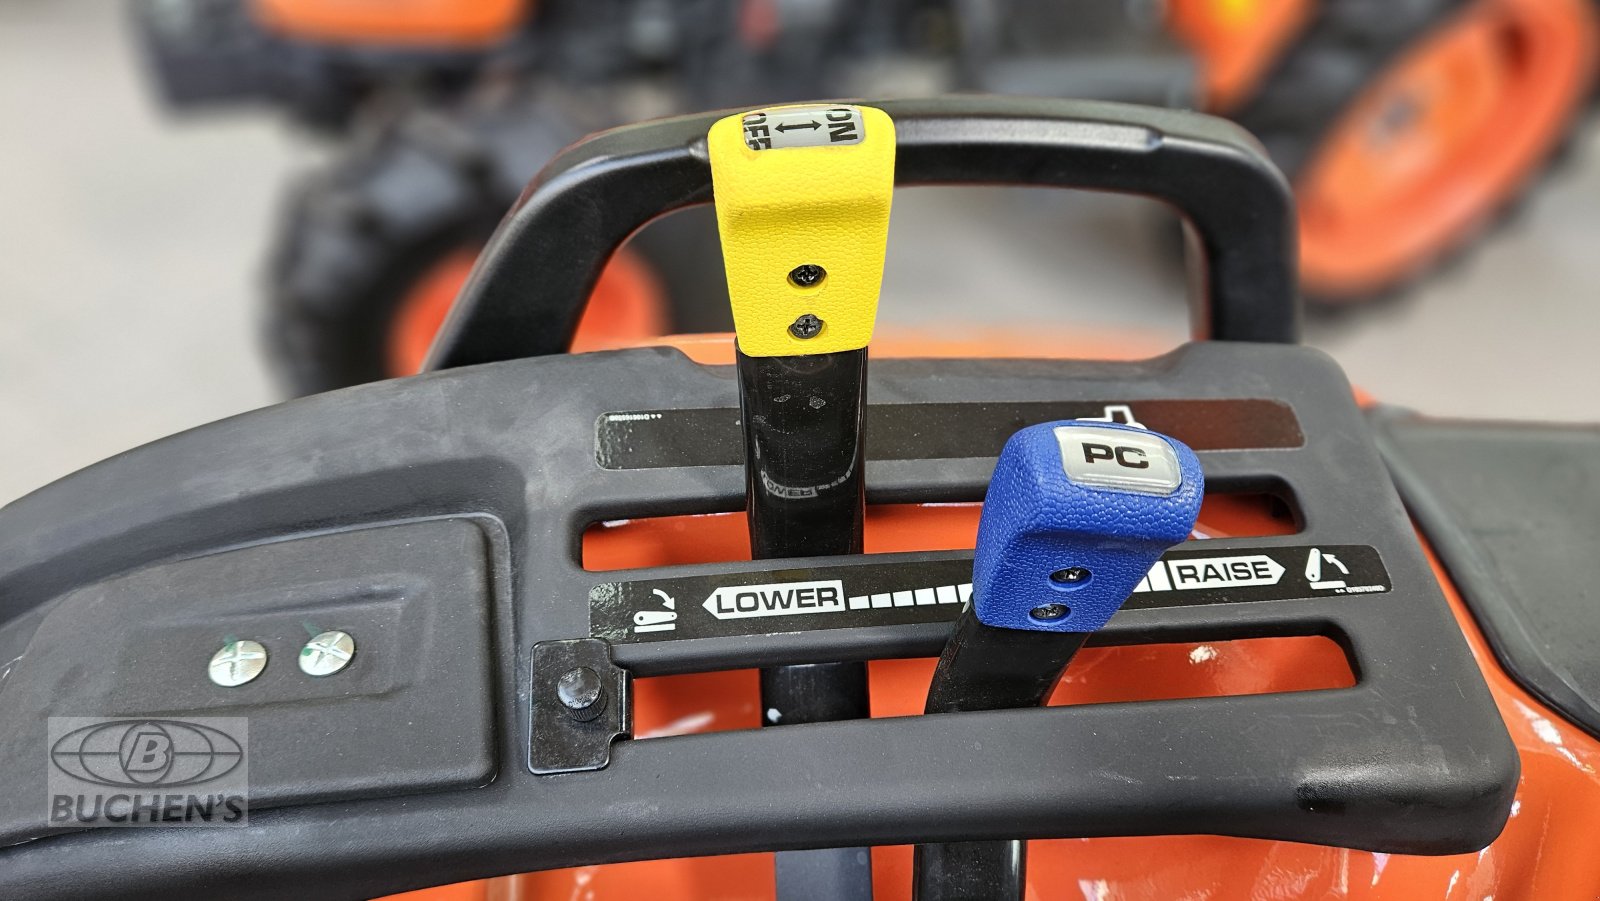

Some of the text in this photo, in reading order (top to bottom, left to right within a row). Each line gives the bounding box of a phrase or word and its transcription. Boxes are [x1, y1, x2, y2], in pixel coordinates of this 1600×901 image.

[826, 108, 858, 142] ON
[1082, 442, 1149, 469] PC
[1176, 561, 1273, 583] RAISE
[716, 587, 839, 613] LOWER
